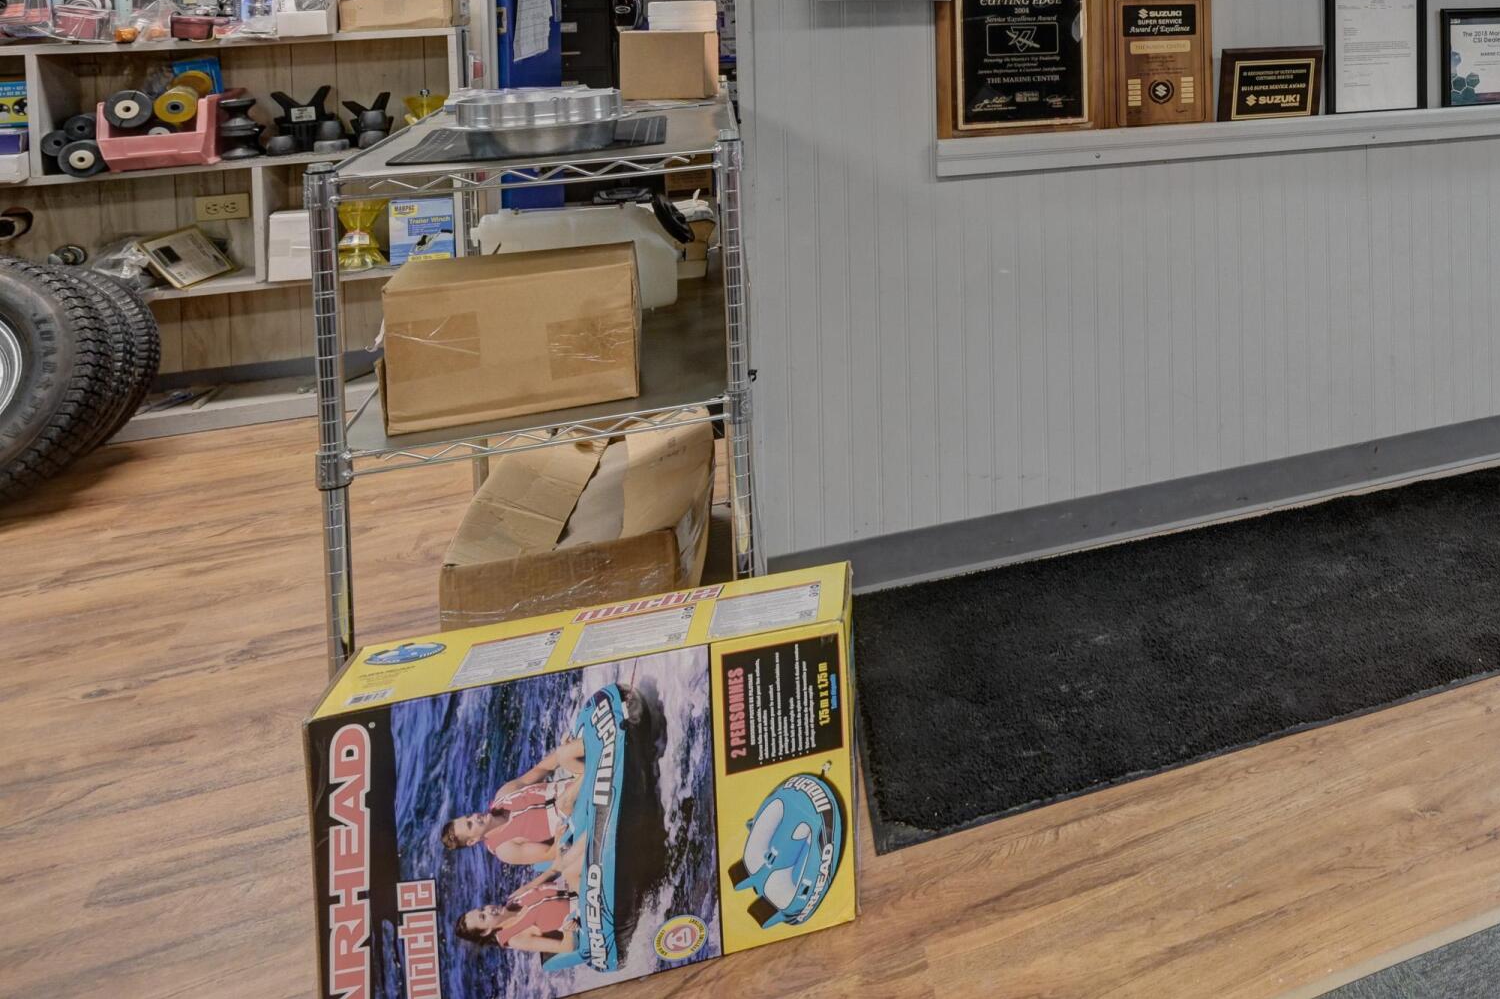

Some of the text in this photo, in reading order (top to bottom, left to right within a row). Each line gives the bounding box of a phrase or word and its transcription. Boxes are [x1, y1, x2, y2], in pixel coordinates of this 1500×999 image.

[1152, 25, 1159, 34] of
[1160, 25, 1190, 33] Excellence
[1258, 94, 1300, 104] SUZUKI
[817, 673, 829, 690] 1,75
[728, 667, 747, 759] 2 PERSONNES
[818, 708, 831, 727] 1,75
[329, 723, 371, 999] IRHEAD
[797, 843, 834, 923] AIRHEAD
[585, 864, 608, 970] AIRHEAD
